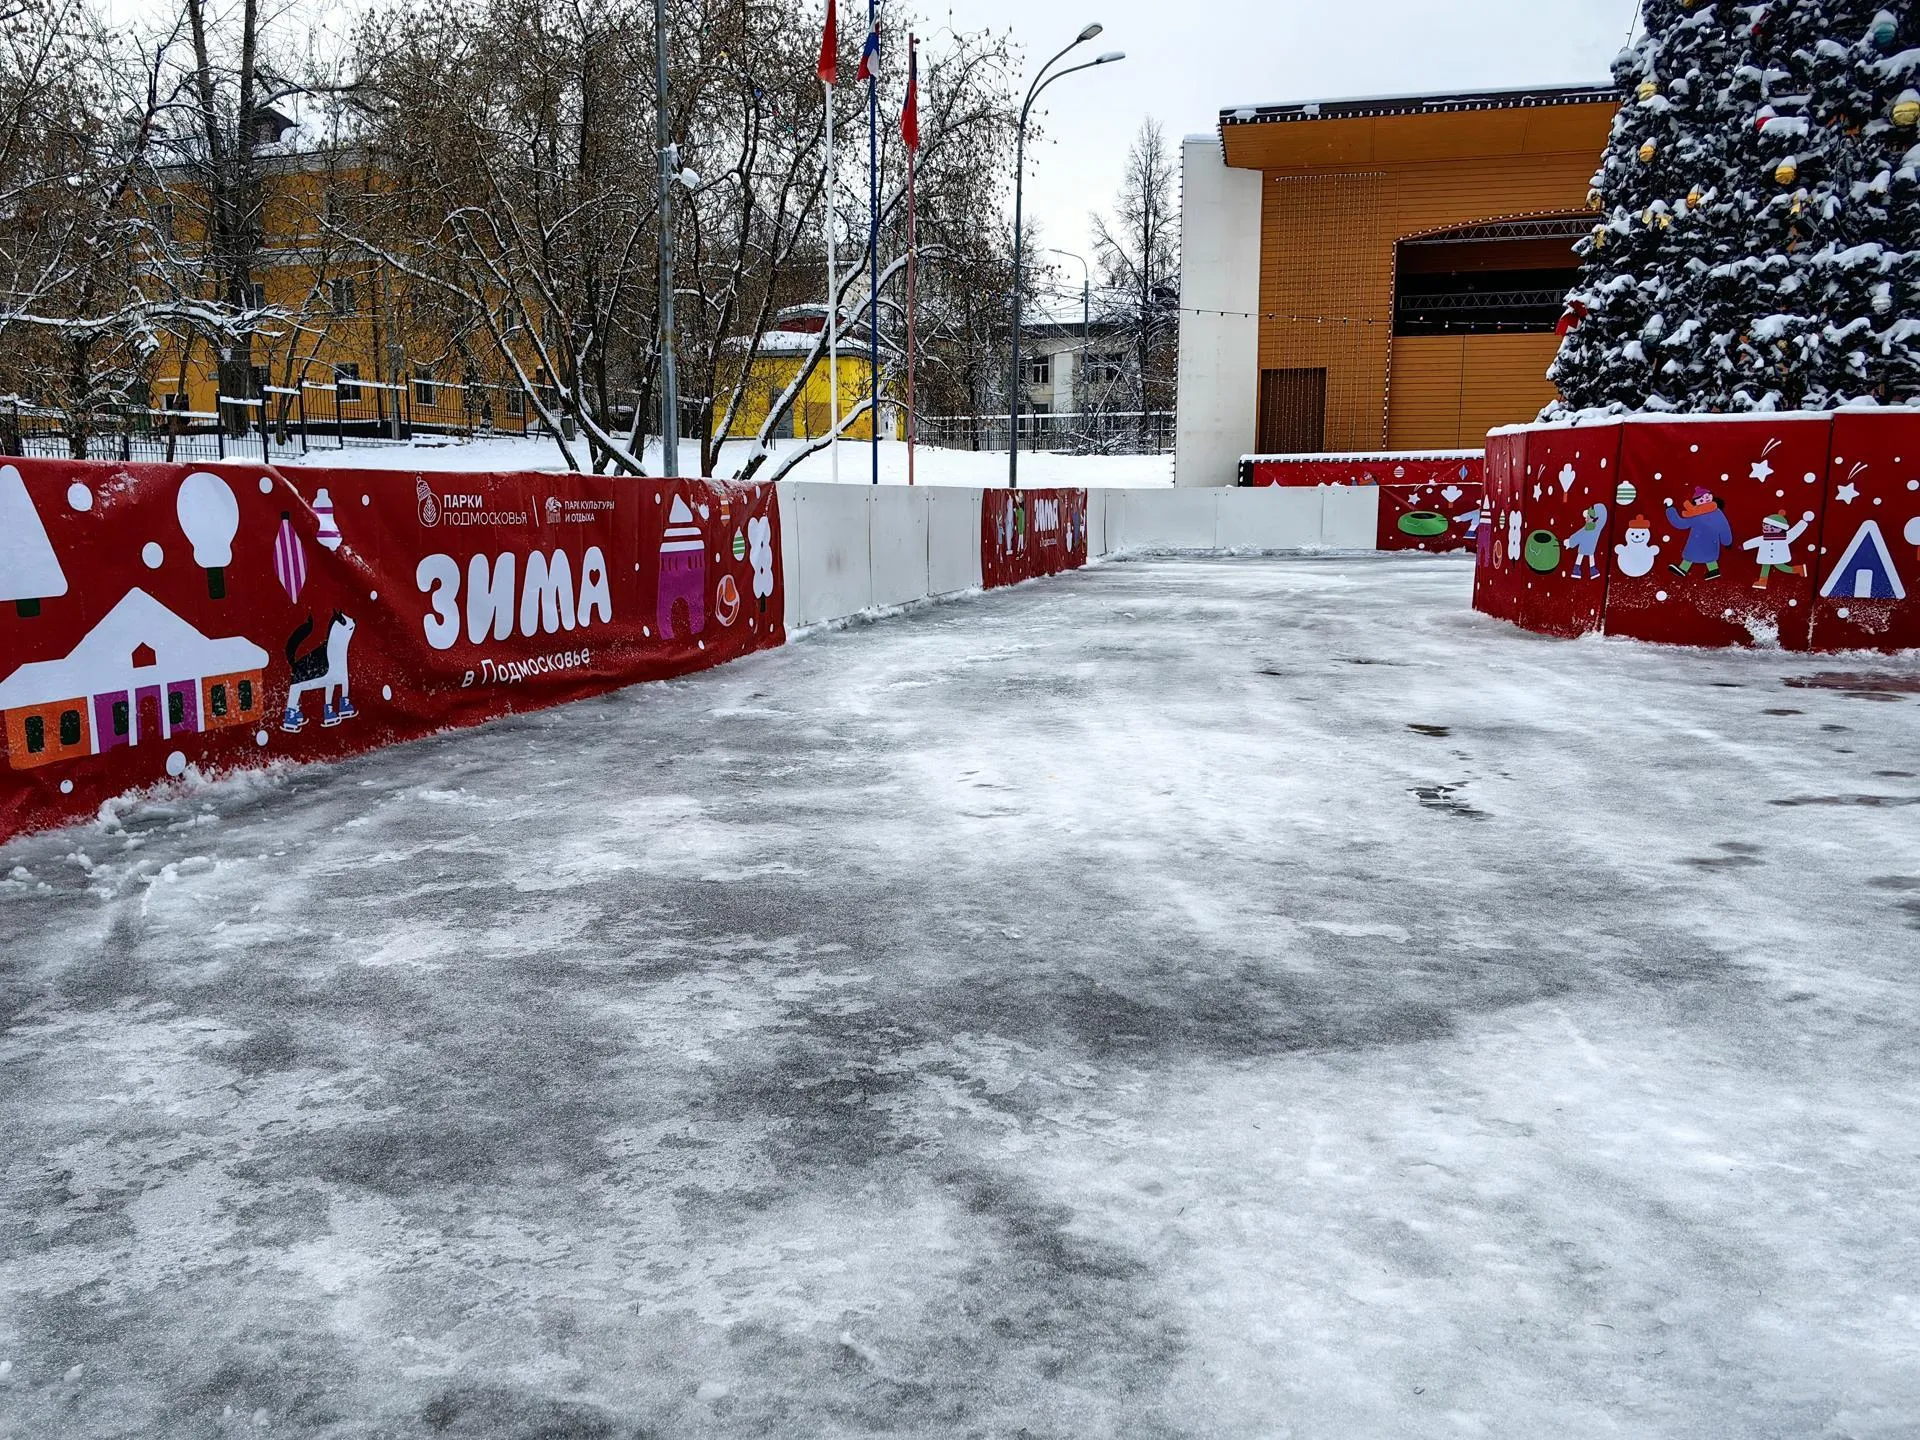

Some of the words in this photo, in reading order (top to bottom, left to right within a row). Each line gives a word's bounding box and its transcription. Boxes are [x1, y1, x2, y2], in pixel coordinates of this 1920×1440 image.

[443, 494, 483, 508] ПАРКИ
[580, 500, 615, 510] КУЛЬТУРЫ
[443, 511, 528, 526] ПОДМОСКОВЬЯ
[564, 513, 571, 522] И
[1034, 498, 1059, 532] ЗИМА
[416, 546, 612, 650] ЗИМА
[461, 670, 475, 688] в
[480, 647, 591, 685] Подмосковье
